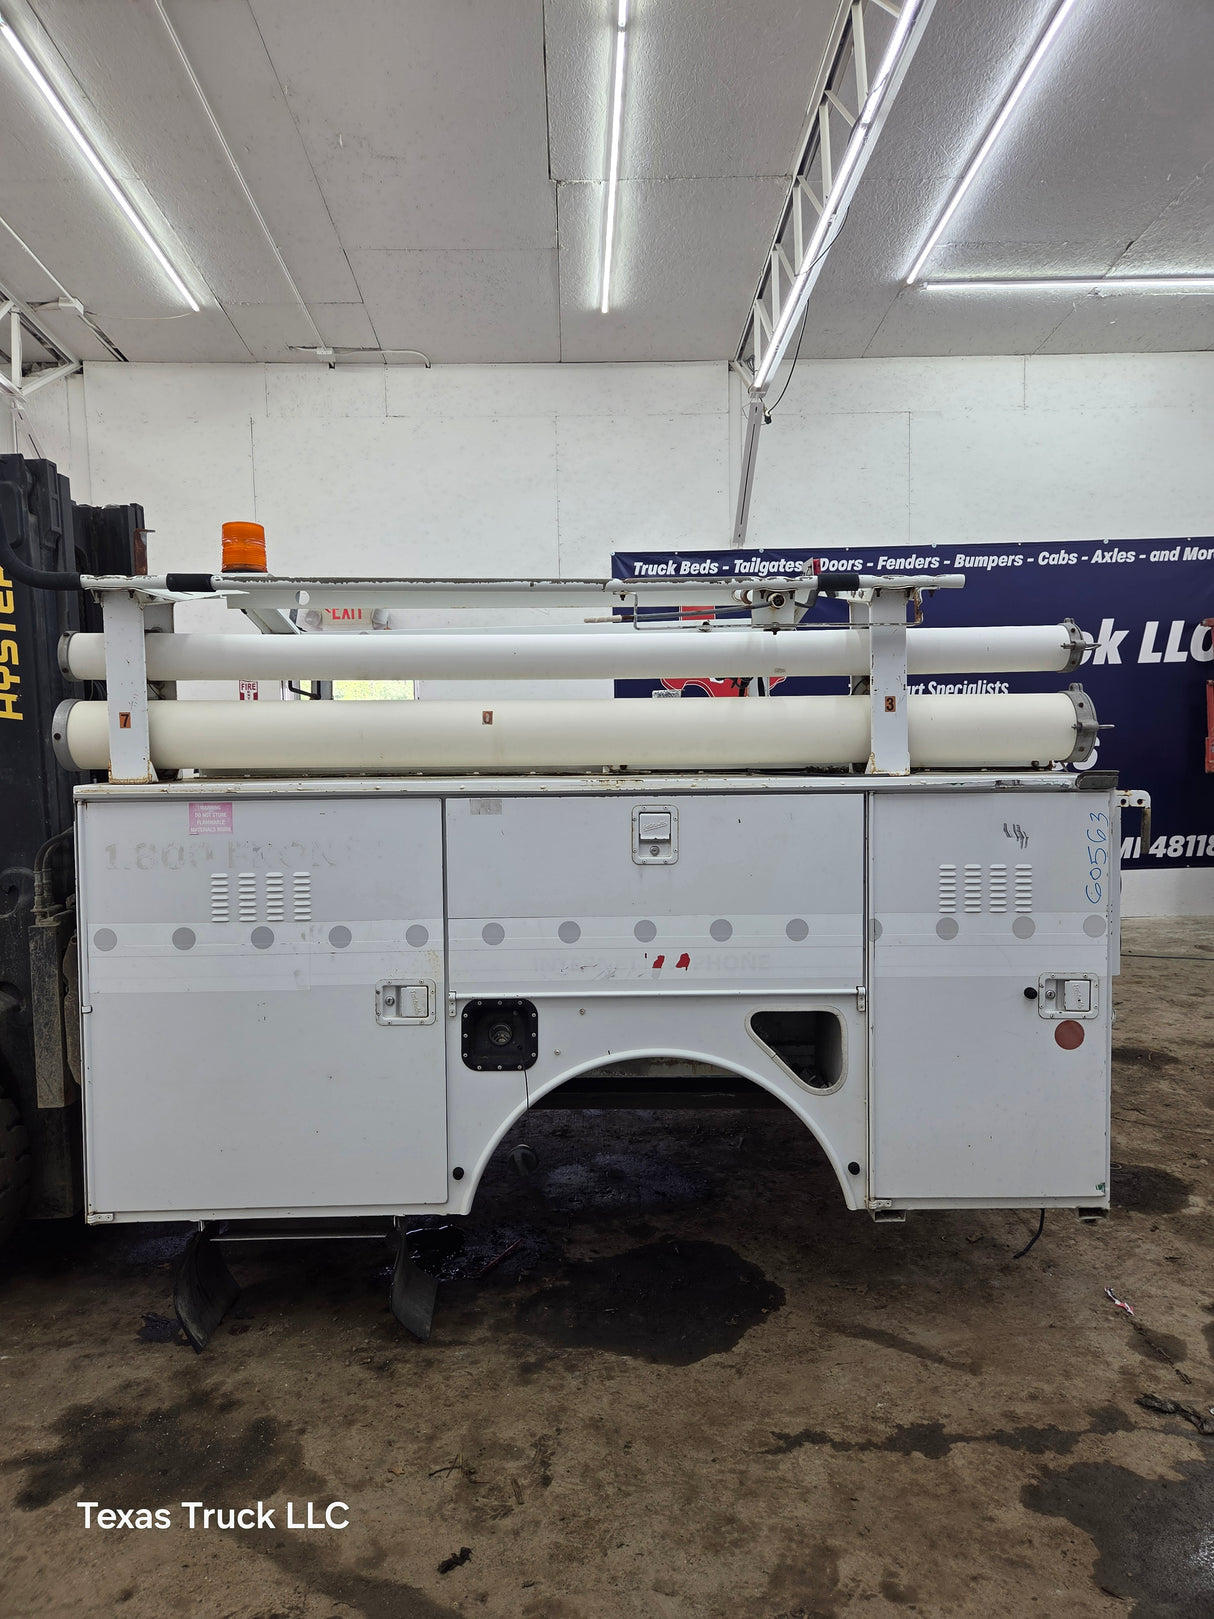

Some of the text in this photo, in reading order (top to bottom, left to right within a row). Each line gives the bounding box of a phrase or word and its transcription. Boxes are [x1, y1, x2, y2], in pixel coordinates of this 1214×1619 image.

[633, 560, 676, 575] Truck
[679, 559, 719, 575] Beds
[734, 557, 804, 577] Tailgates
[819, 557, 863, 572] Doors
[877, 555, 940, 570] Fenders
[954, 553, 1024, 571] Bumpers
[1038, 551, 1078, 566] Cabs
[1091, 549, 1136, 564] Axles
[1150, 546, 1181, 562] and
[241, 683, 256, 691] FIRE
[886, 697, 895, 712] 3
[120, 714, 129, 727] 7
